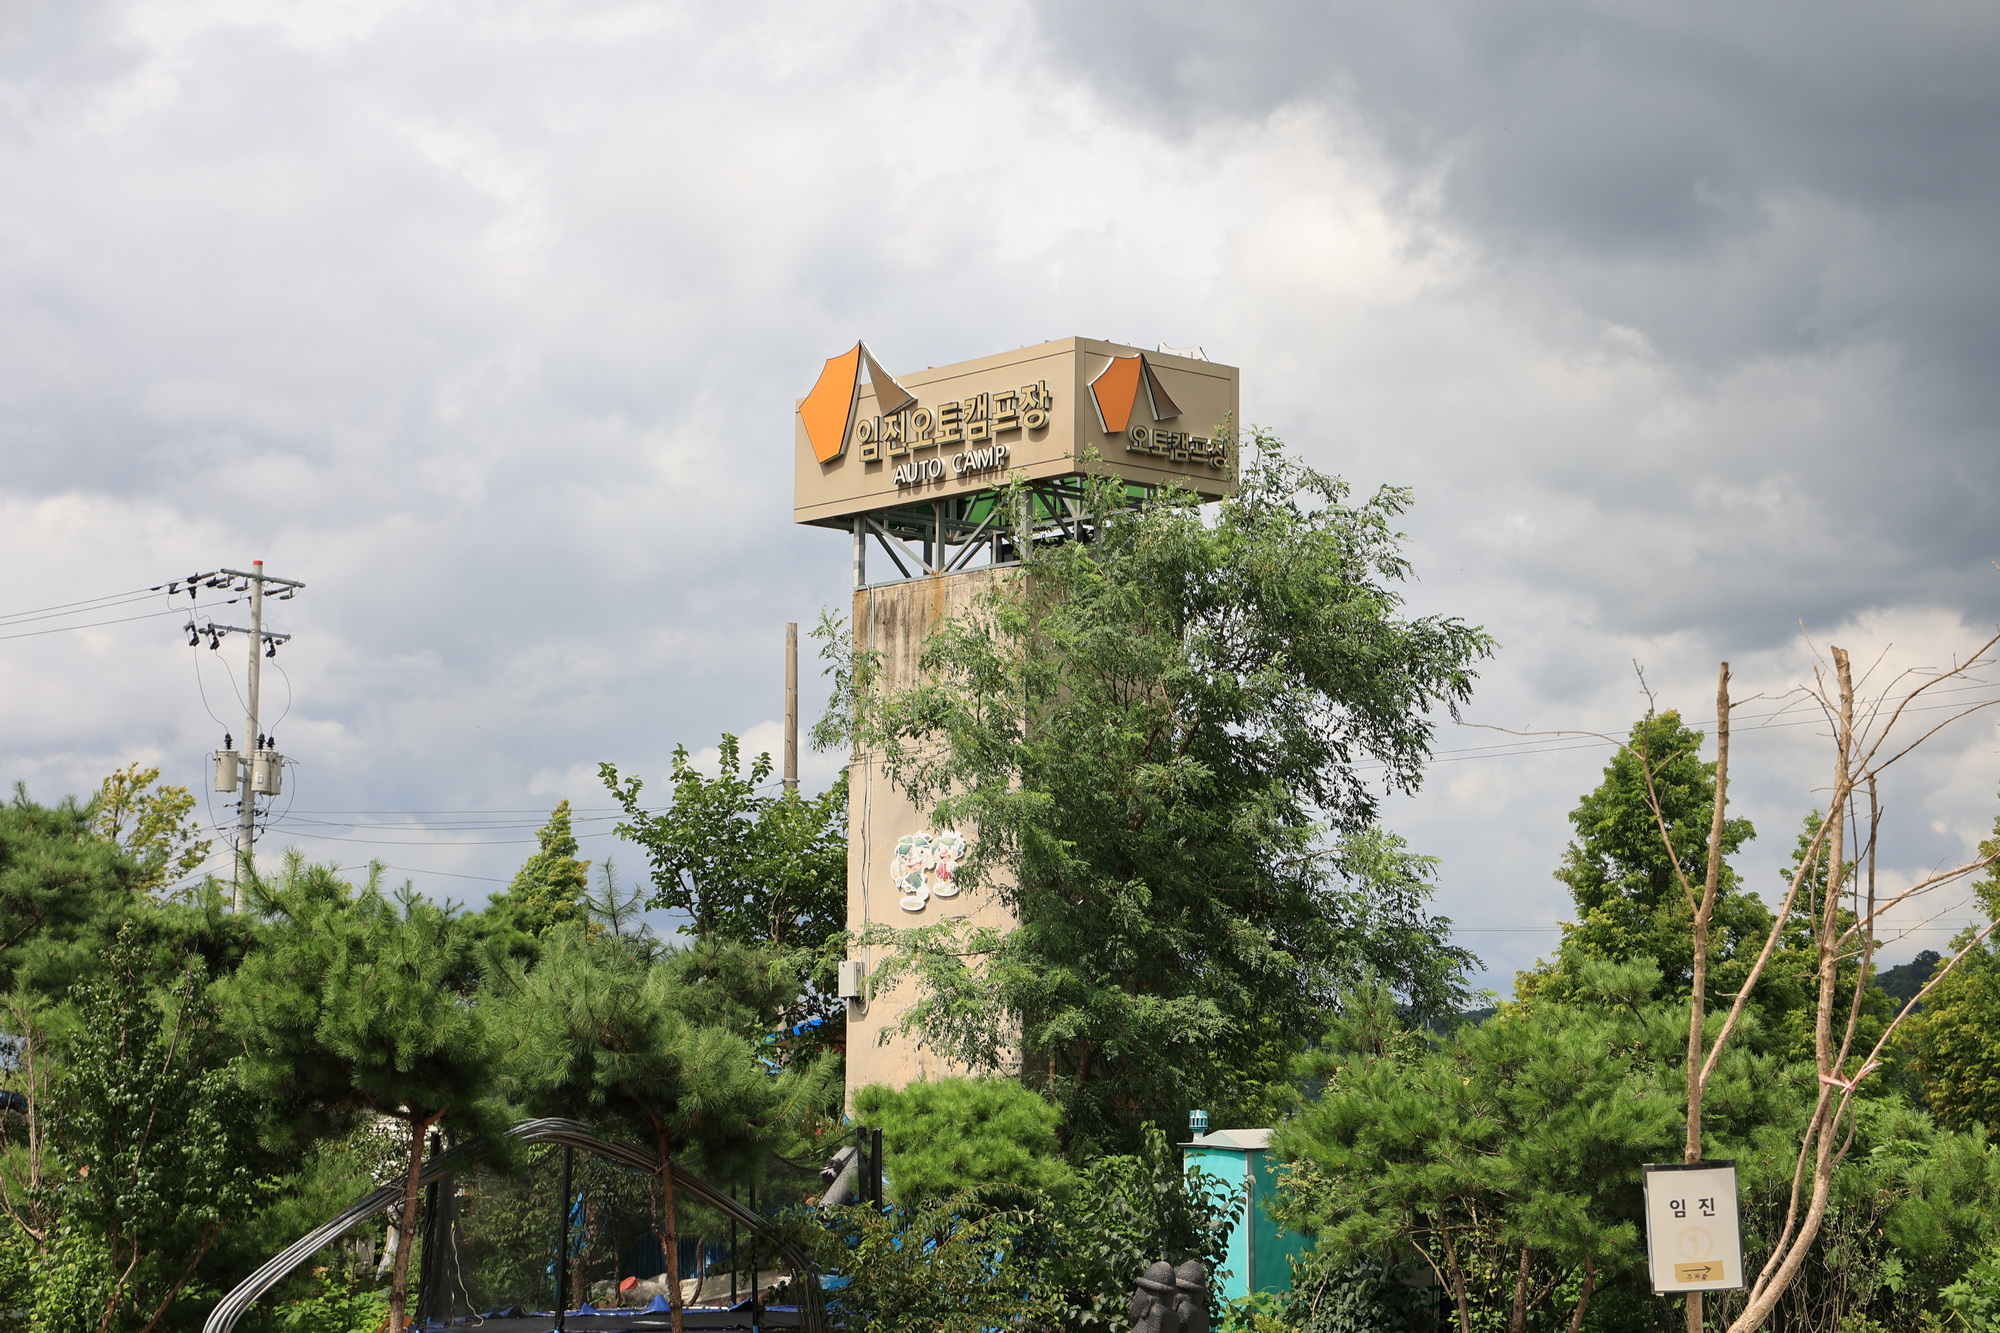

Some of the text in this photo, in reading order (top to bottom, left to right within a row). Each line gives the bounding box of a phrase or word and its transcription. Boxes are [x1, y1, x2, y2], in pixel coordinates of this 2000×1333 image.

[856, 380, 1052, 462] 임진오토캠프장
[892, 444, 1010, 485] AUTO CAMP
[1125, 424, 1228, 469] 오토캠프장
